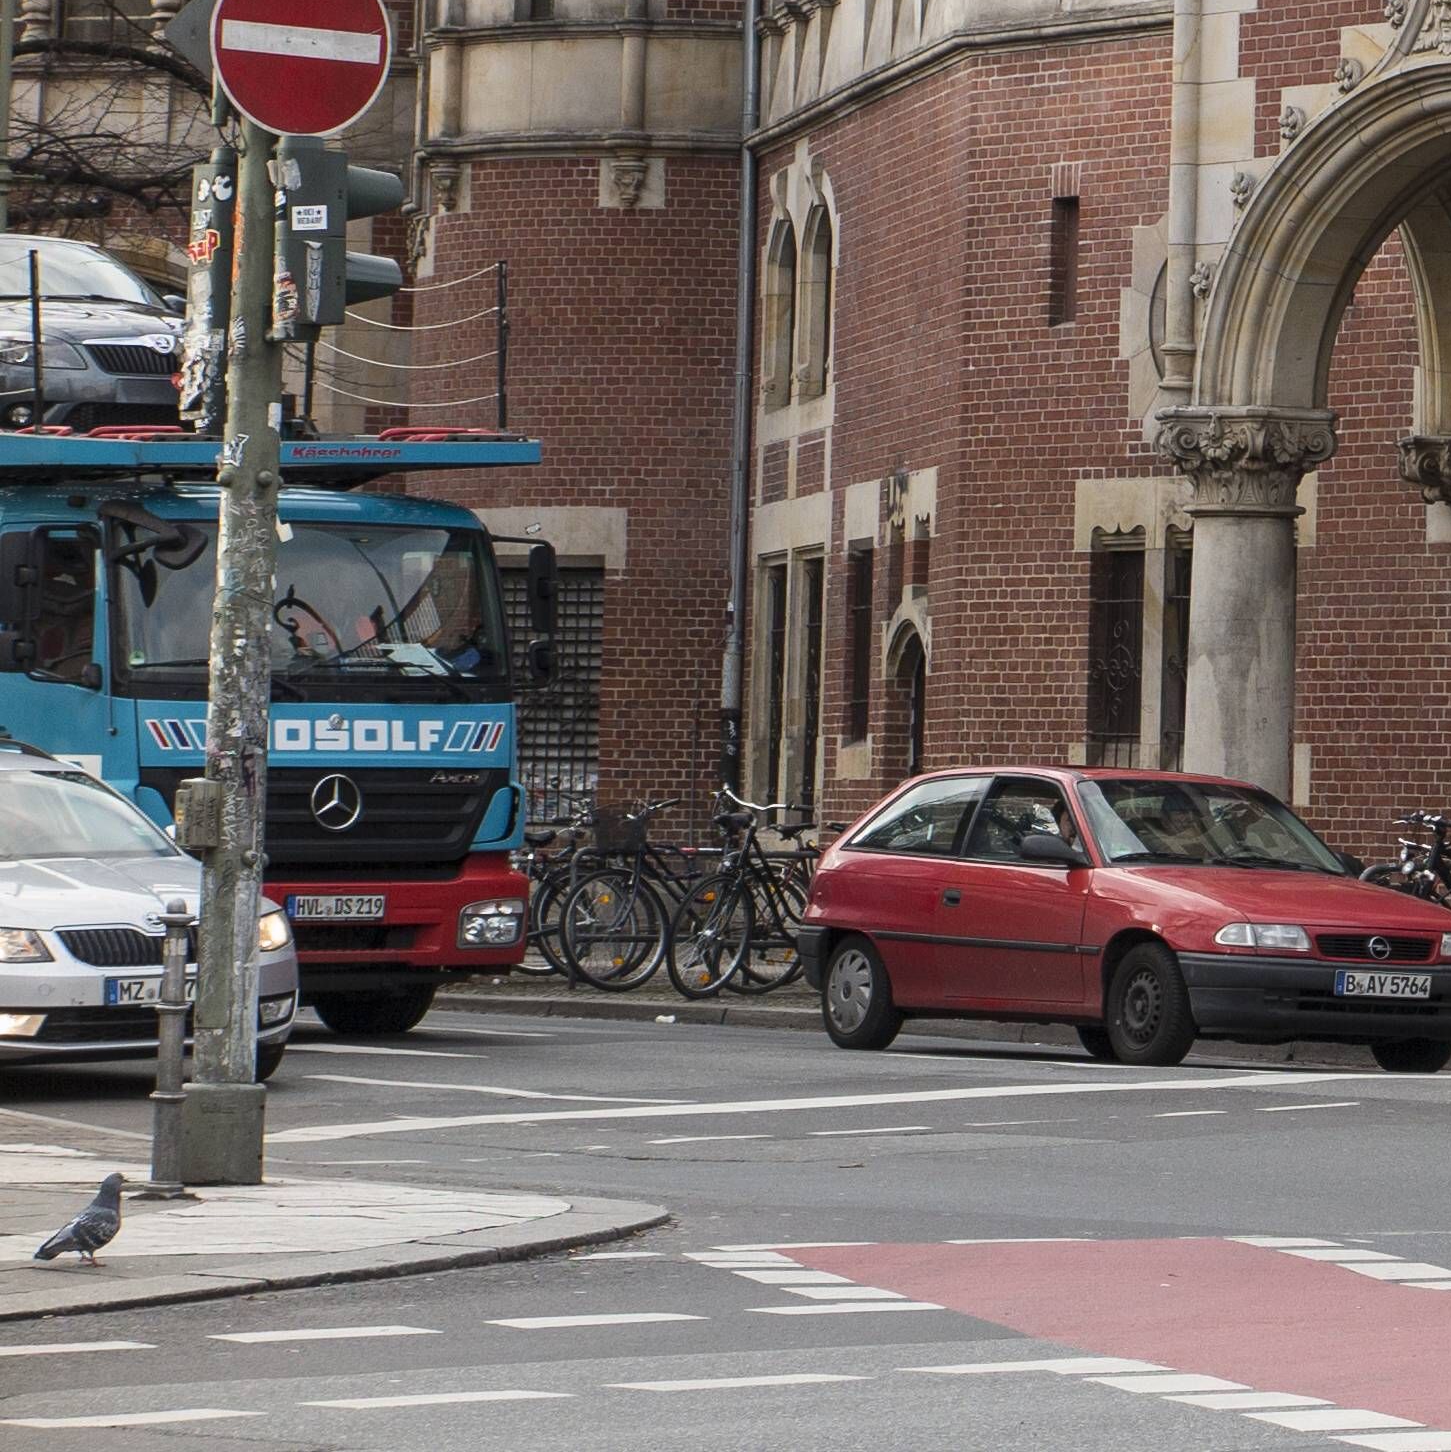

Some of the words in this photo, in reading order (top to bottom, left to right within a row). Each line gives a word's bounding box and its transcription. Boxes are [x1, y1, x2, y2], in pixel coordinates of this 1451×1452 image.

[267, 720, 444, 751] OSOLF
[296, 898, 323, 916] HVL
[334, 898, 352, 915] DS
[356, 897, 383, 915] 219
[119, 981, 144, 1001] MZ
[1345, 975, 1356, 993] B
[1366, 976, 1388, 994] AY
[1390, 976, 1429, 996] 5764
